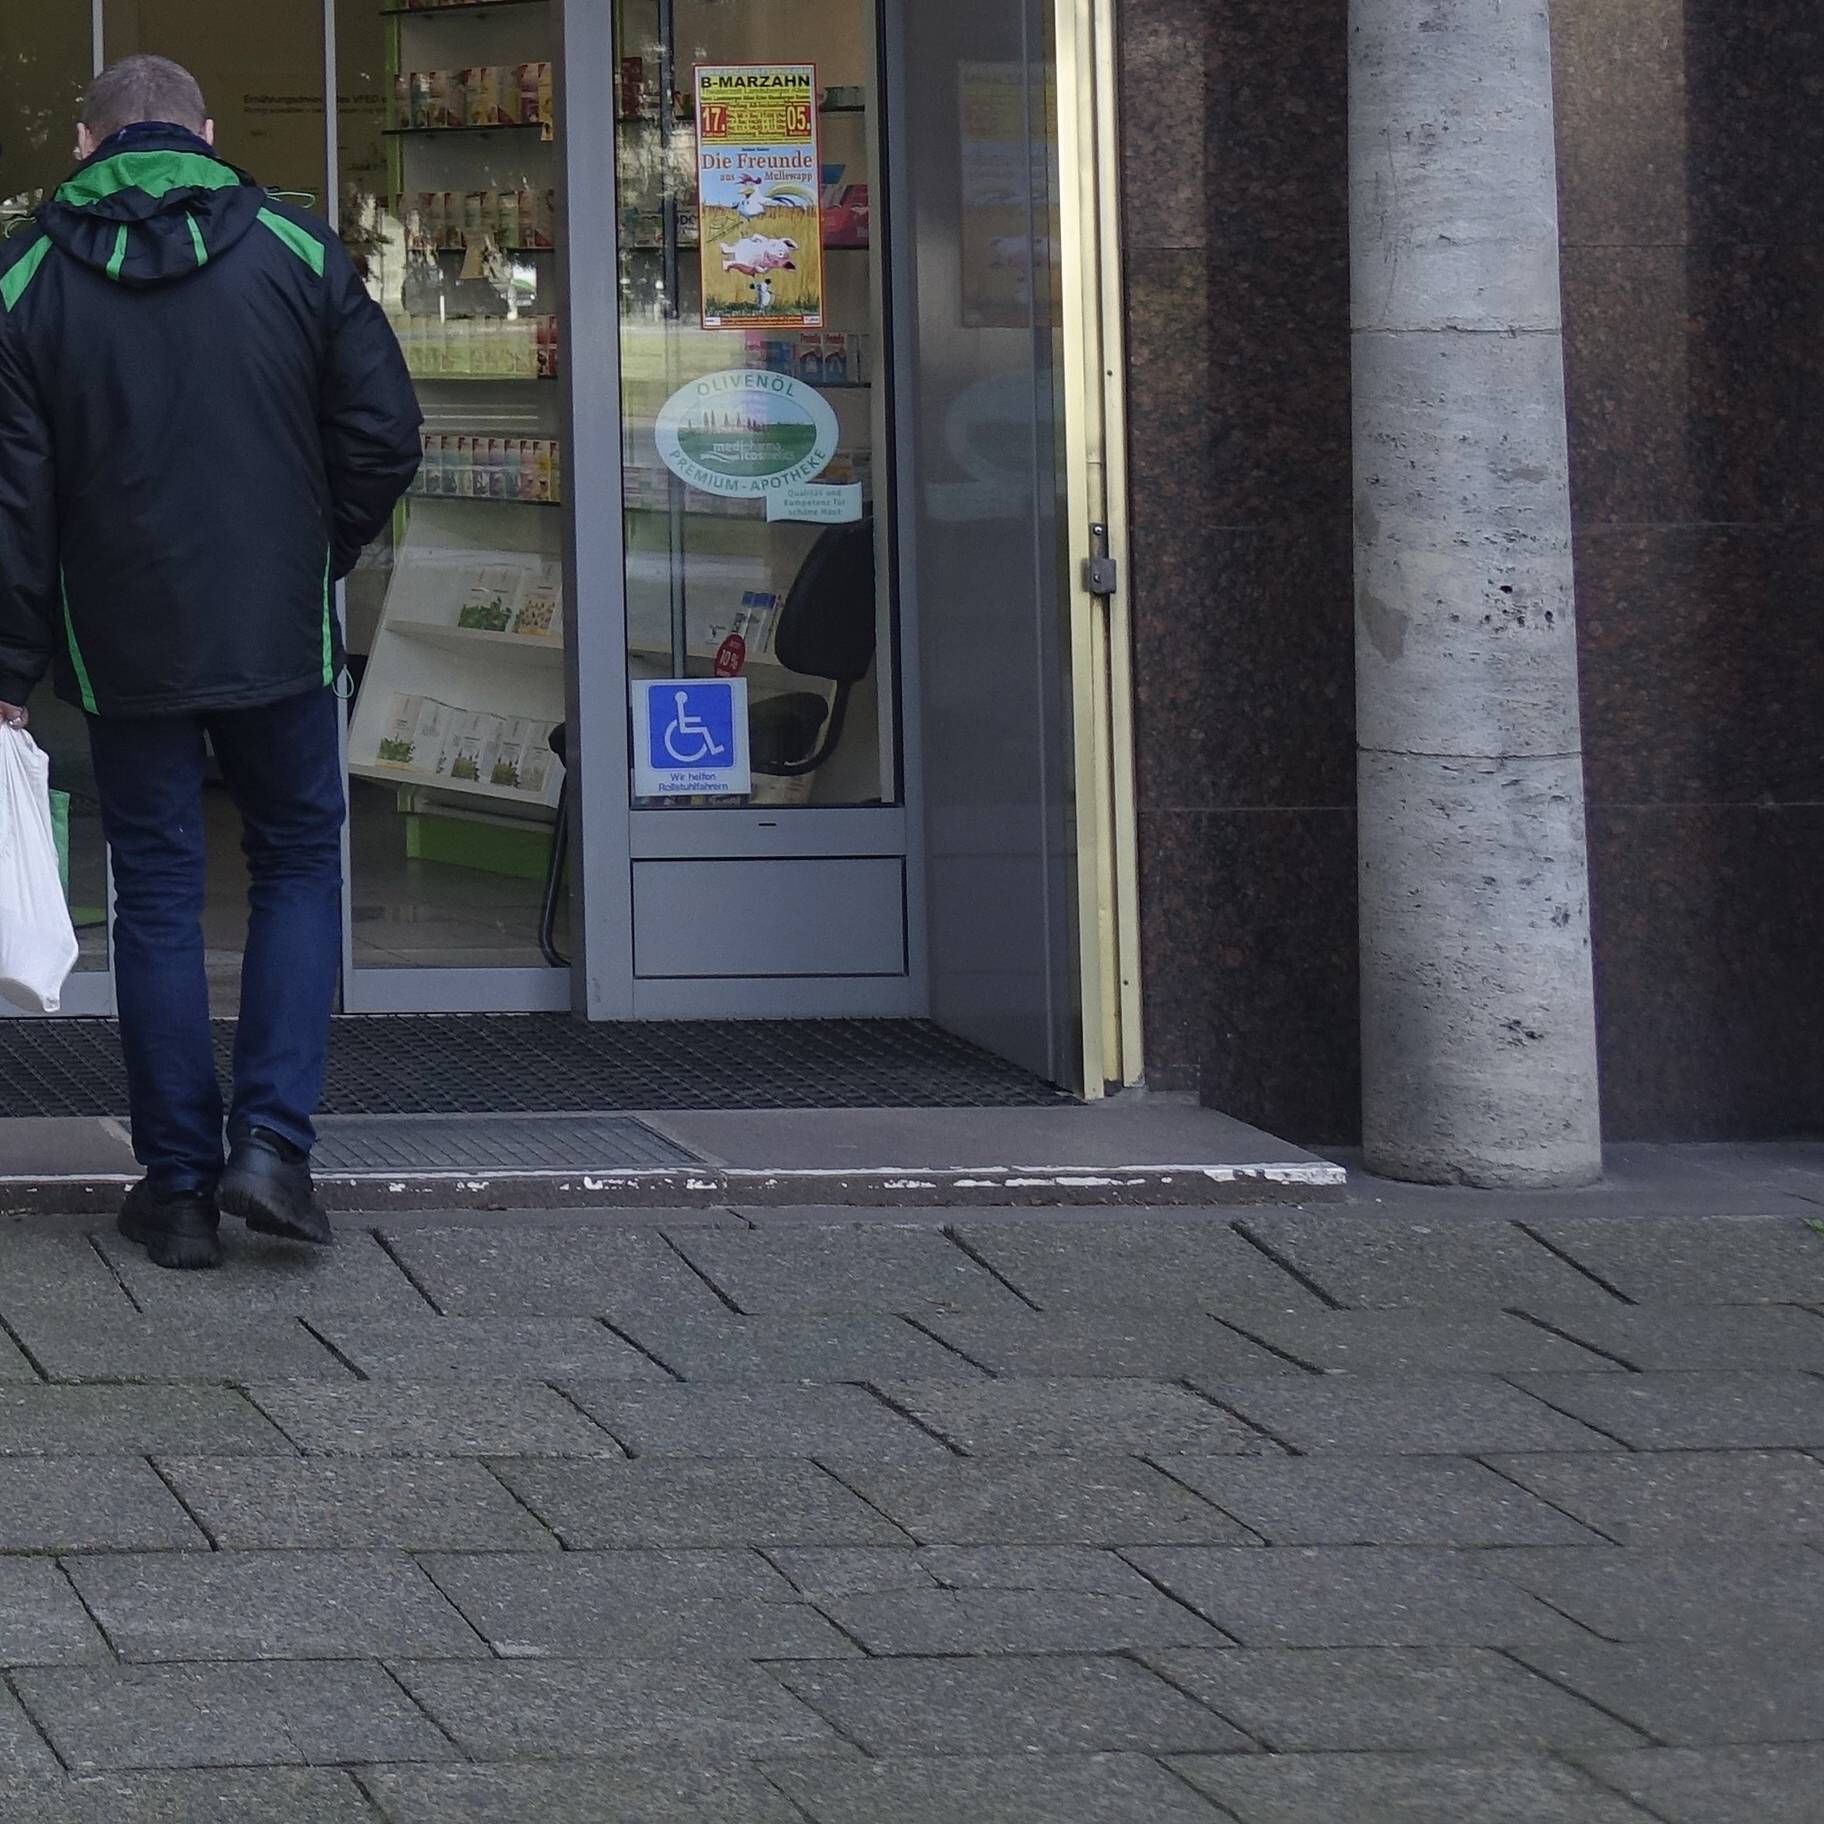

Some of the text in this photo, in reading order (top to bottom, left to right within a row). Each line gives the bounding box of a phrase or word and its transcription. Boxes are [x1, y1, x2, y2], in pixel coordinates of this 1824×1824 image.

[700, 75, 810, 88] B-MARZAHN
[702, 107, 726, 132] 17.
[786, 105, 810, 131] 05.
[702, 150, 812, 169] Die Freunde
[697, 374, 795, 398] OLIVENÖL
[670, 771, 716, 781] Wir helfen
